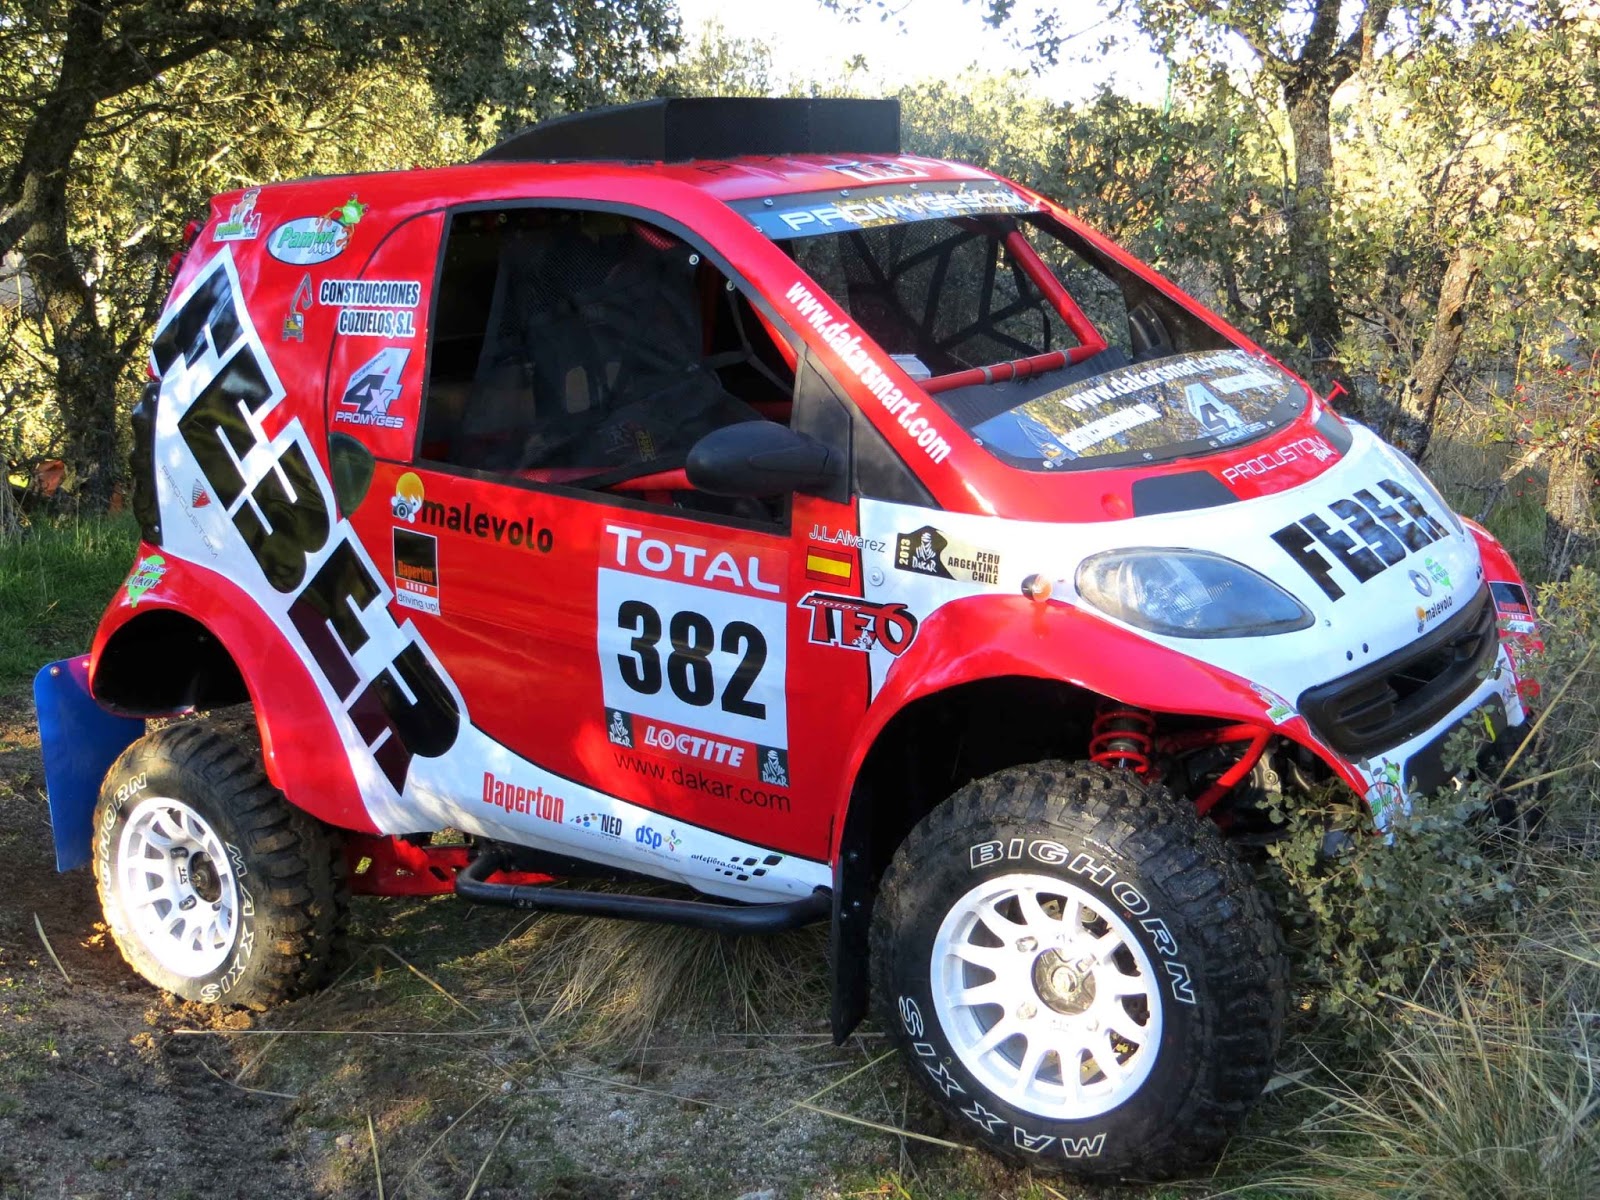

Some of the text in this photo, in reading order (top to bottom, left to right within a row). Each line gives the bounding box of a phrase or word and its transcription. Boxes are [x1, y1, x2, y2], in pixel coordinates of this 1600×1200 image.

[320, 281, 419, 305] CONSTRUCCIONES
[340, 311, 394, 336] COZUELOS,
[785, 281, 952, 464] www.dakarsmart.com
[335, 411, 404, 428] PROMYGES
[1221, 436, 1338, 485] PROCUSTOM
[151, 262, 461, 797] FEBER
[421, 501, 553, 553] malevolo
[809, 524, 887, 553] J.L.Alvarez
[1270, 479, 1450, 602] FEBER
[606, 524, 780, 594] TOTAL
[899, 538, 911, 566] 2013
[947, 556, 999, 574] ARGENTINA
[976, 551, 1001, 564] PERU
[405, 581, 428, 594] GROUP
[971, 571, 999, 585] CHILE
[397, 593, 424, 609] driving
[810, 599, 862, 611] MOTOS
[1425, 595, 1453, 622] malevolo
[797, 591, 919, 657] TEO
[617, 600, 768, 720] 382
[643, 725, 745, 768] LOCTITE
[482, 771, 565, 824] Daperton
[614, 752, 791, 812] www.dakar.com
[601, 814, 622, 837] NED
[200, 842, 255, 1003] MAXXIS
[970, 838, 1197, 1005] BIGHORN
[899, 995, 1107, 1158] MAXXIS
